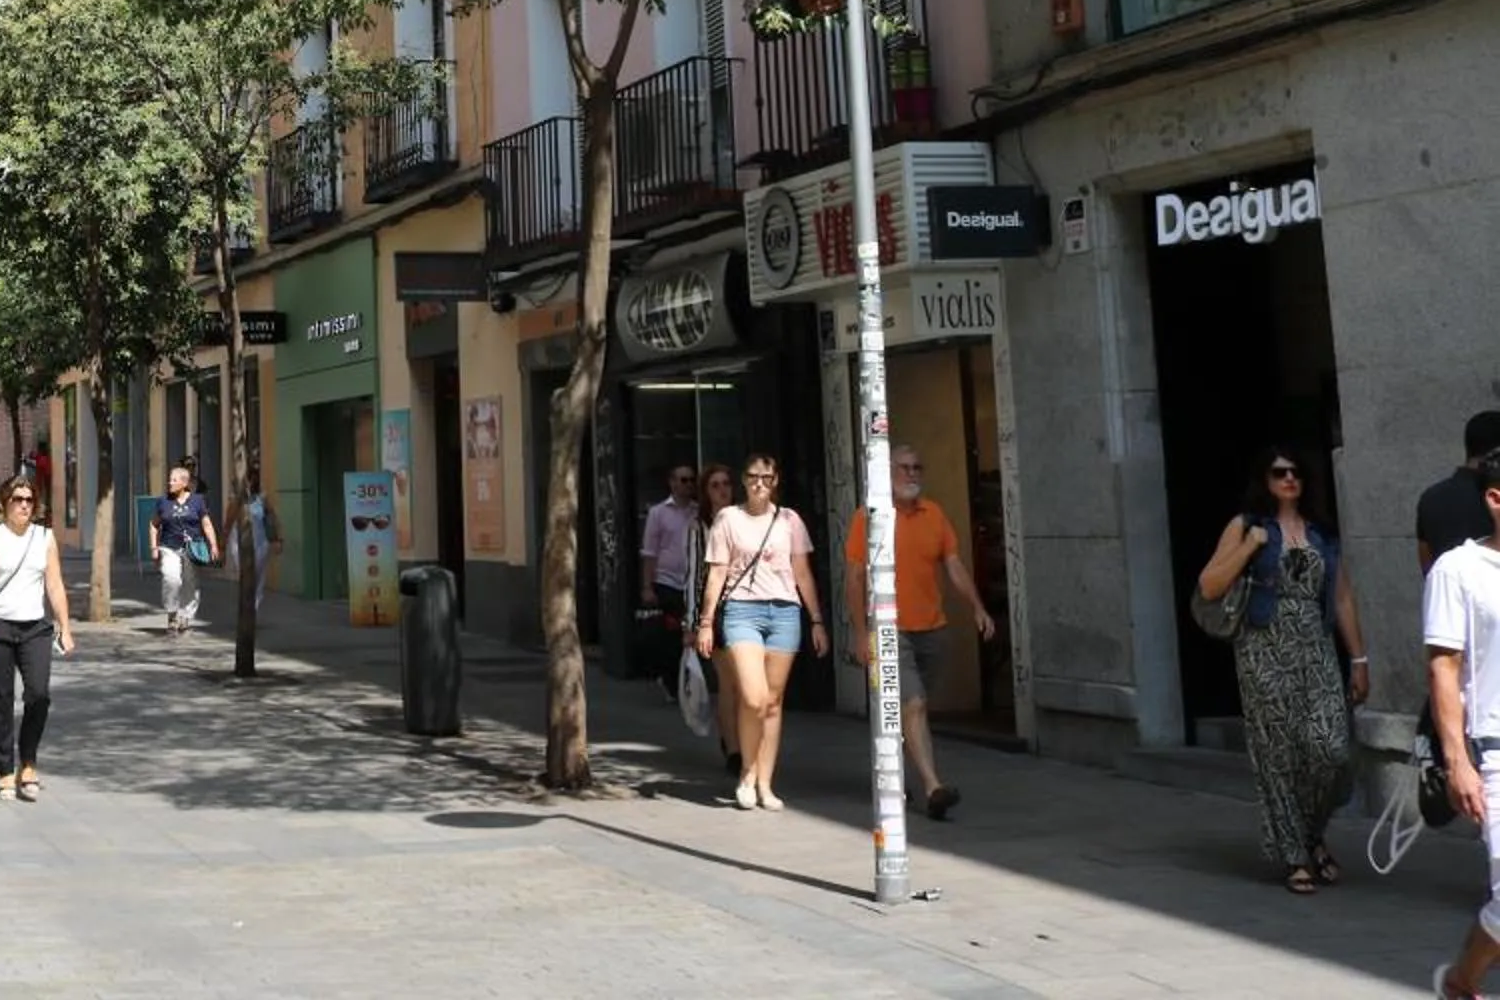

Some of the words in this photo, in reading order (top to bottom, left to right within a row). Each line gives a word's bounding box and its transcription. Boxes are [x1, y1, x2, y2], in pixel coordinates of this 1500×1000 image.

[947, 211, 1020, 231] Desigual
[921, 279, 996, 329] vialis
[351, 483, 389, 498] -30%
[882, 665, 897, 693] BNE
[884, 701, 900, 731] BNE
